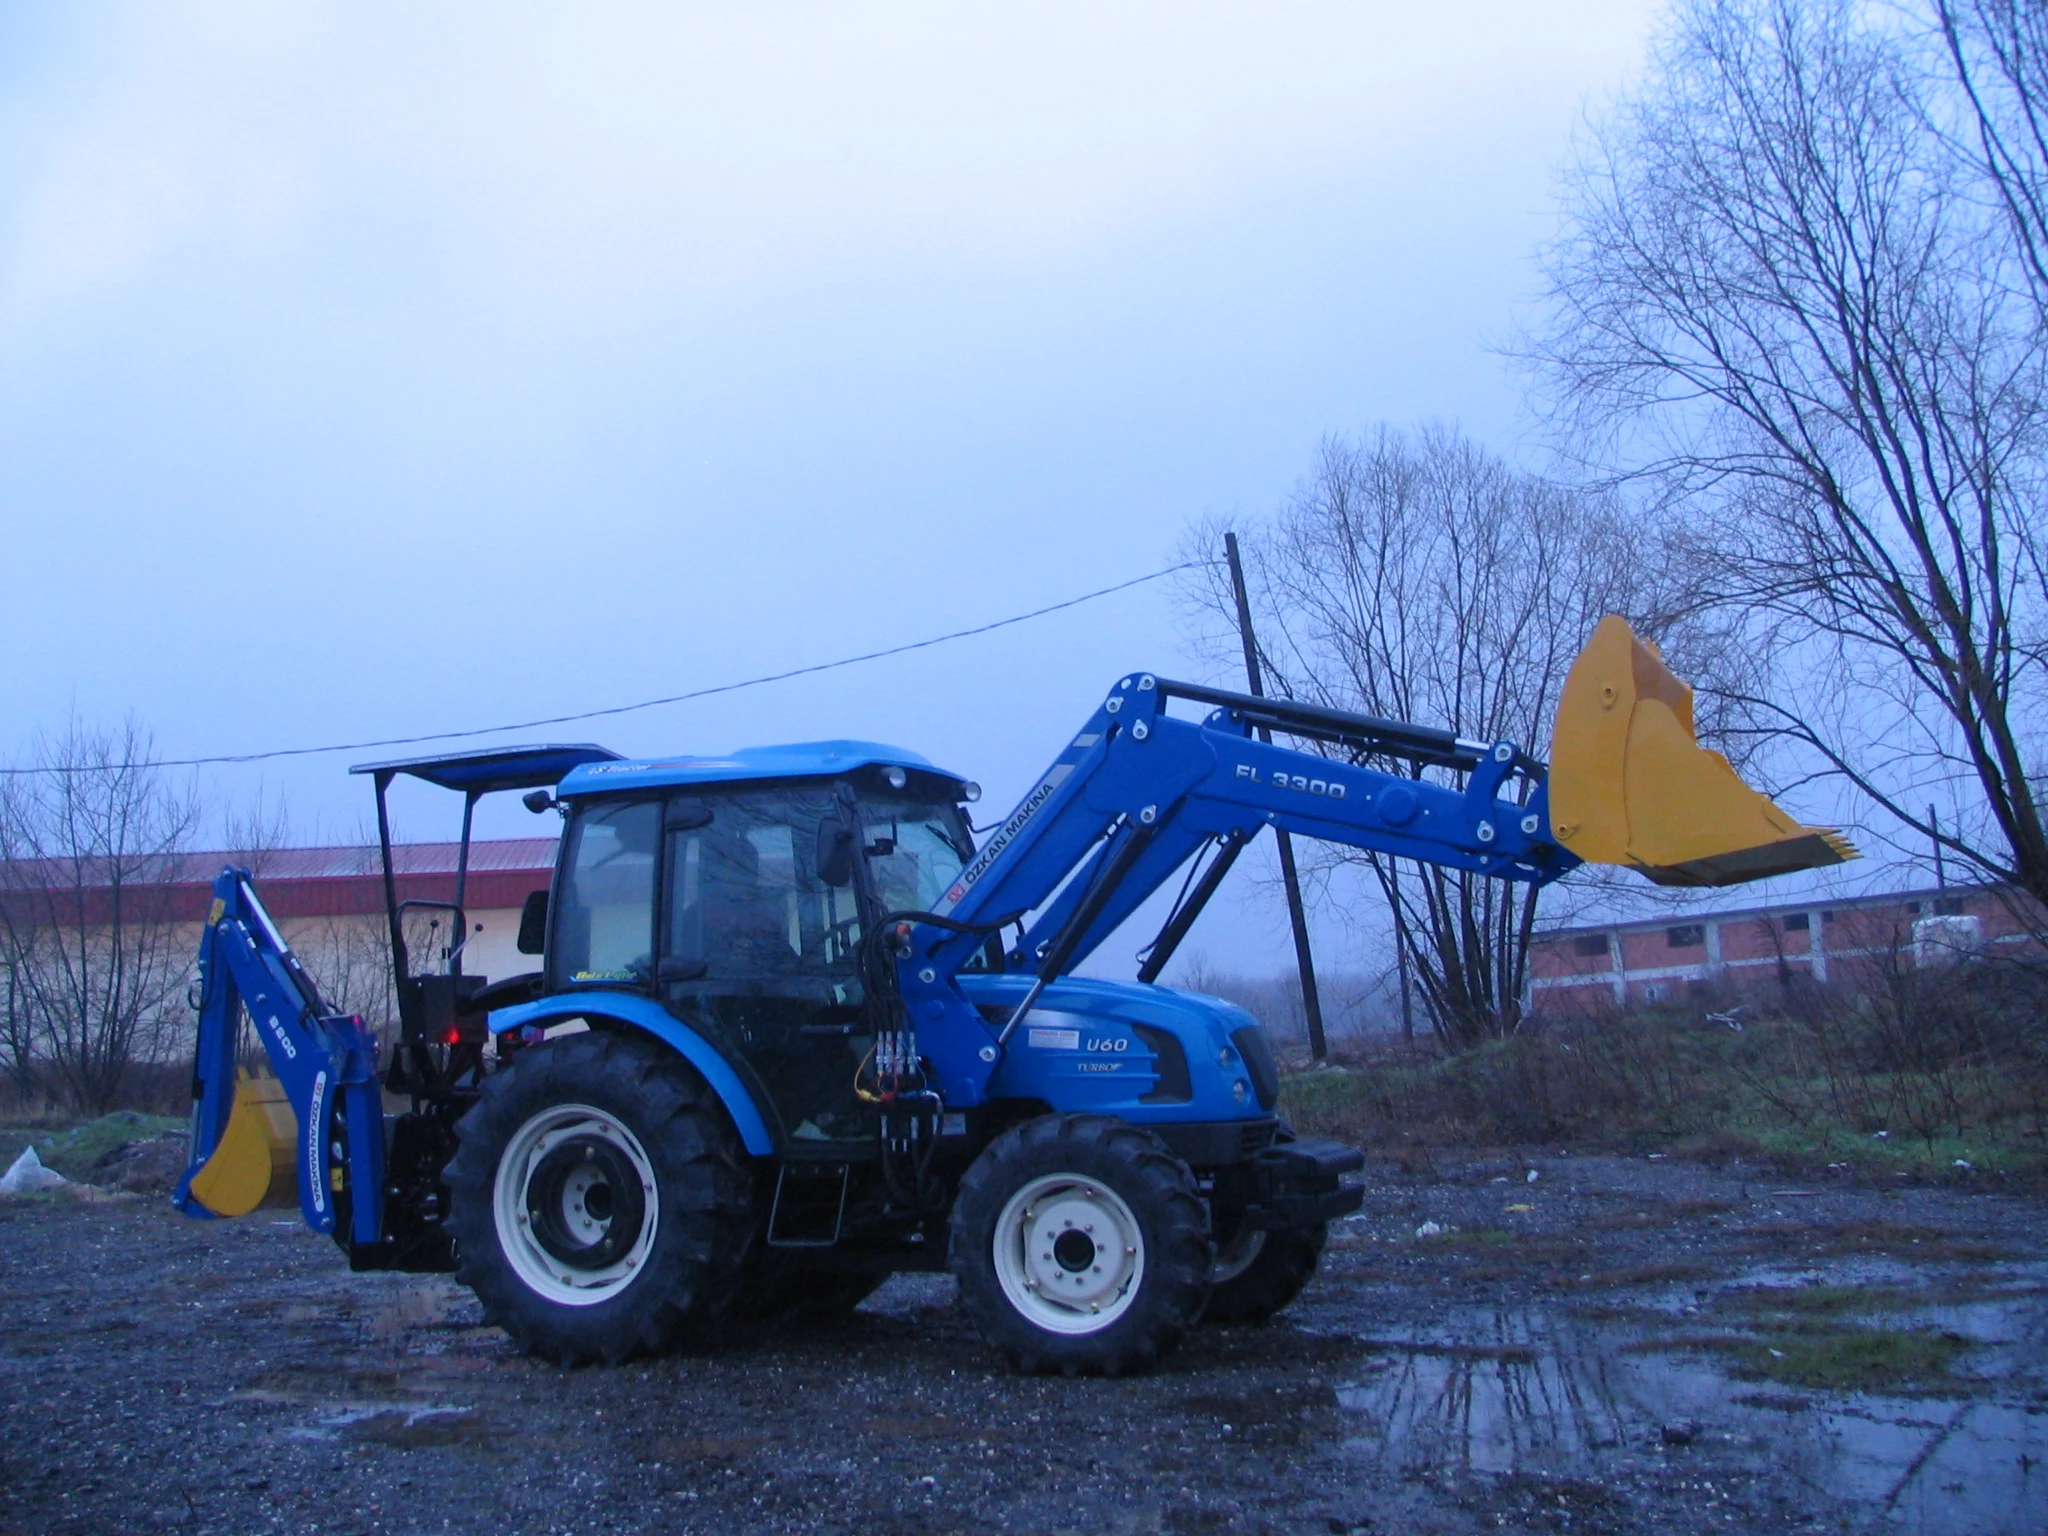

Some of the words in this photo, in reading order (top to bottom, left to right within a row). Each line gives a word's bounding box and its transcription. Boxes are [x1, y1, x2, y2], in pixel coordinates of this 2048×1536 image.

[1235, 764, 1262, 784] FL
[1272, 771, 1346, 799] 3300
[964, 835, 1008, 885] ÖZKAN
[1086, 1038, 1128, 1052] U60
